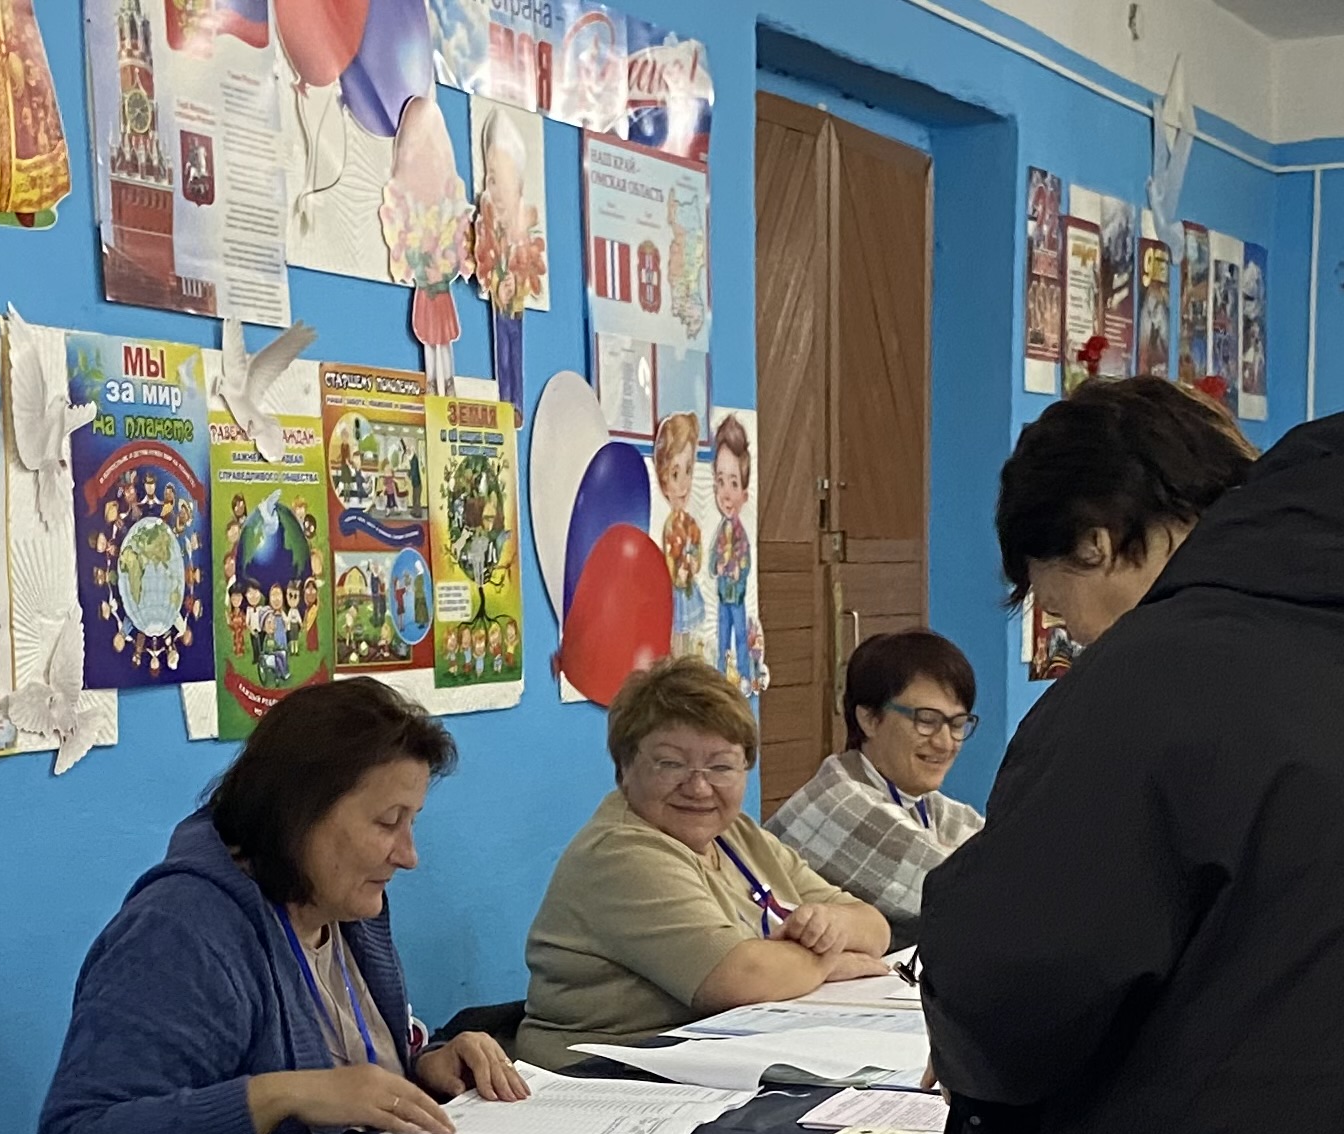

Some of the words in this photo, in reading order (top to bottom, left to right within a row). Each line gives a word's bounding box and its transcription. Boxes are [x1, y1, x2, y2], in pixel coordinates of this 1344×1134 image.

[123, 345, 166, 379] МЫ
[106, 380, 134, 403] за
[142, 383, 182, 413] мир
[209, 424, 248, 444] РАВЕН
